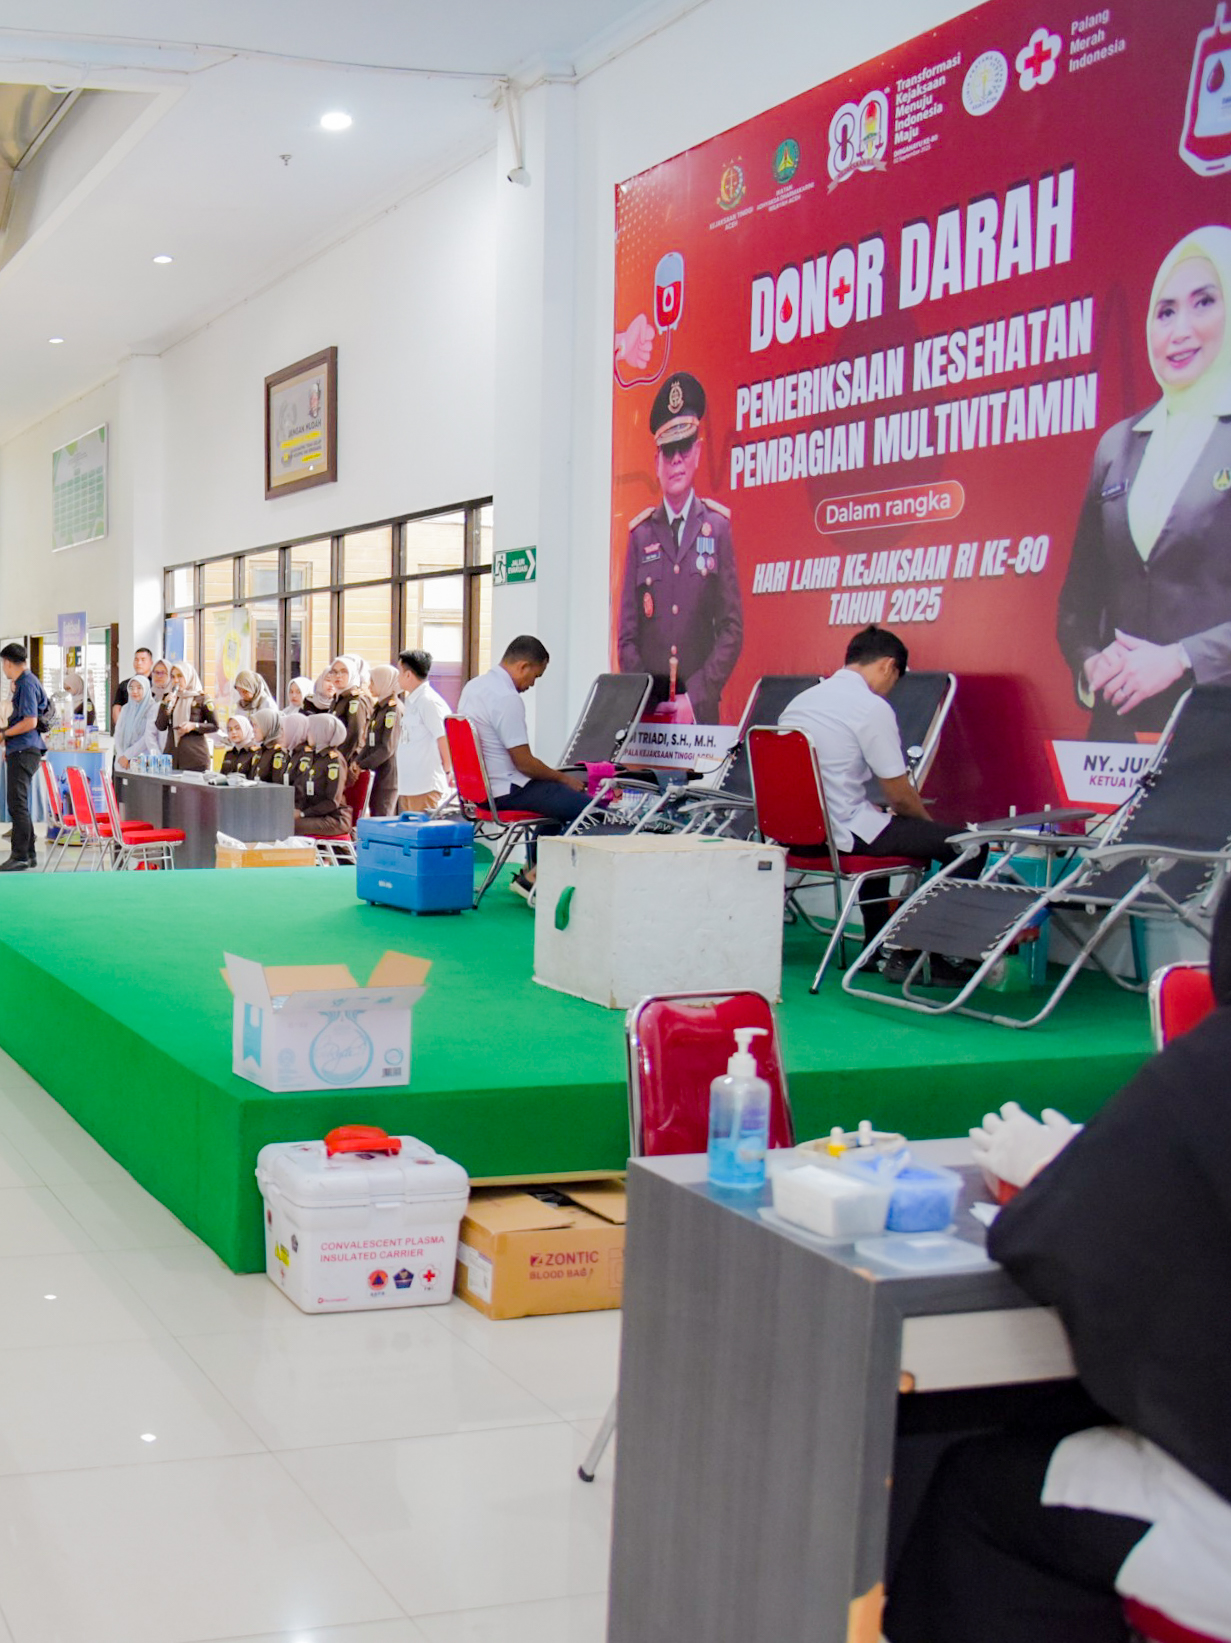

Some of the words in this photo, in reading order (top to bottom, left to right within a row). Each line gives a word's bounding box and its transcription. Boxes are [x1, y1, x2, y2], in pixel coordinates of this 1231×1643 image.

[1071, 9, 1110, 36] Palang
[1070, 29, 1105, 55] Merah
[1069, 38, 1126, 73] Indonesia
[896, 51, 961, 92] Transformasi
[895, 75, 946, 105] Kejaksaan
[894, 102, 943, 132] Indonesia
[895, 95, 933, 119] Menuju
[894, 127, 919, 145] Maju
[725, 220, 738, 231] ACEH
[750, 236, 886, 353] DONOR
[898, 168, 1075, 310] DARAH
[736, 346, 905, 432] PEMERIKSAAN
[912, 297, 1094, 392] KESEHATAN
[730, 420, 866, 490] PEMBAGIAN
[873, 372, 1098, 466] MULTIVITAMIN
[825, 502, 881, 525] Dalam
[885, 491, 951, 518] rangka
[752, 561, 791, 595] HARI
[791, 556, 841, 591] LAHIR
[841, 545, 953, 588] KEJAKSAAN
[953, 542, 979, 579] RI
[979, 535, 1050, 577] KE-80
[828, 590, 886, 625] TAHUN
[887, 587, 944, 623] 2025
[638, 731, 669, 747] TRIADI,
[671, 733, 692, 748] S.H.,
[694, 734, 717, 748] M.H.
[639, 749, 673, 759] KEJAKSAAN
[674, 751, 695, 760] TINGGI
[1083, 755, 1114, 773] NY.
[1089, 775, 1126, 788] KETUA
[320, 1251, 376, 1262] INSULATED
[379, 1249, 424, 1260] CARRIER
[321, 1239, 402, 1251] CONVALESCENT
[405, 1236, 445, 1246] PLASMA
[545, 1251, 599, 1266] ZONTIC
[529, 1270, 564, 1280] BLOOD
[567, 1267, 588, 1278] BAG
